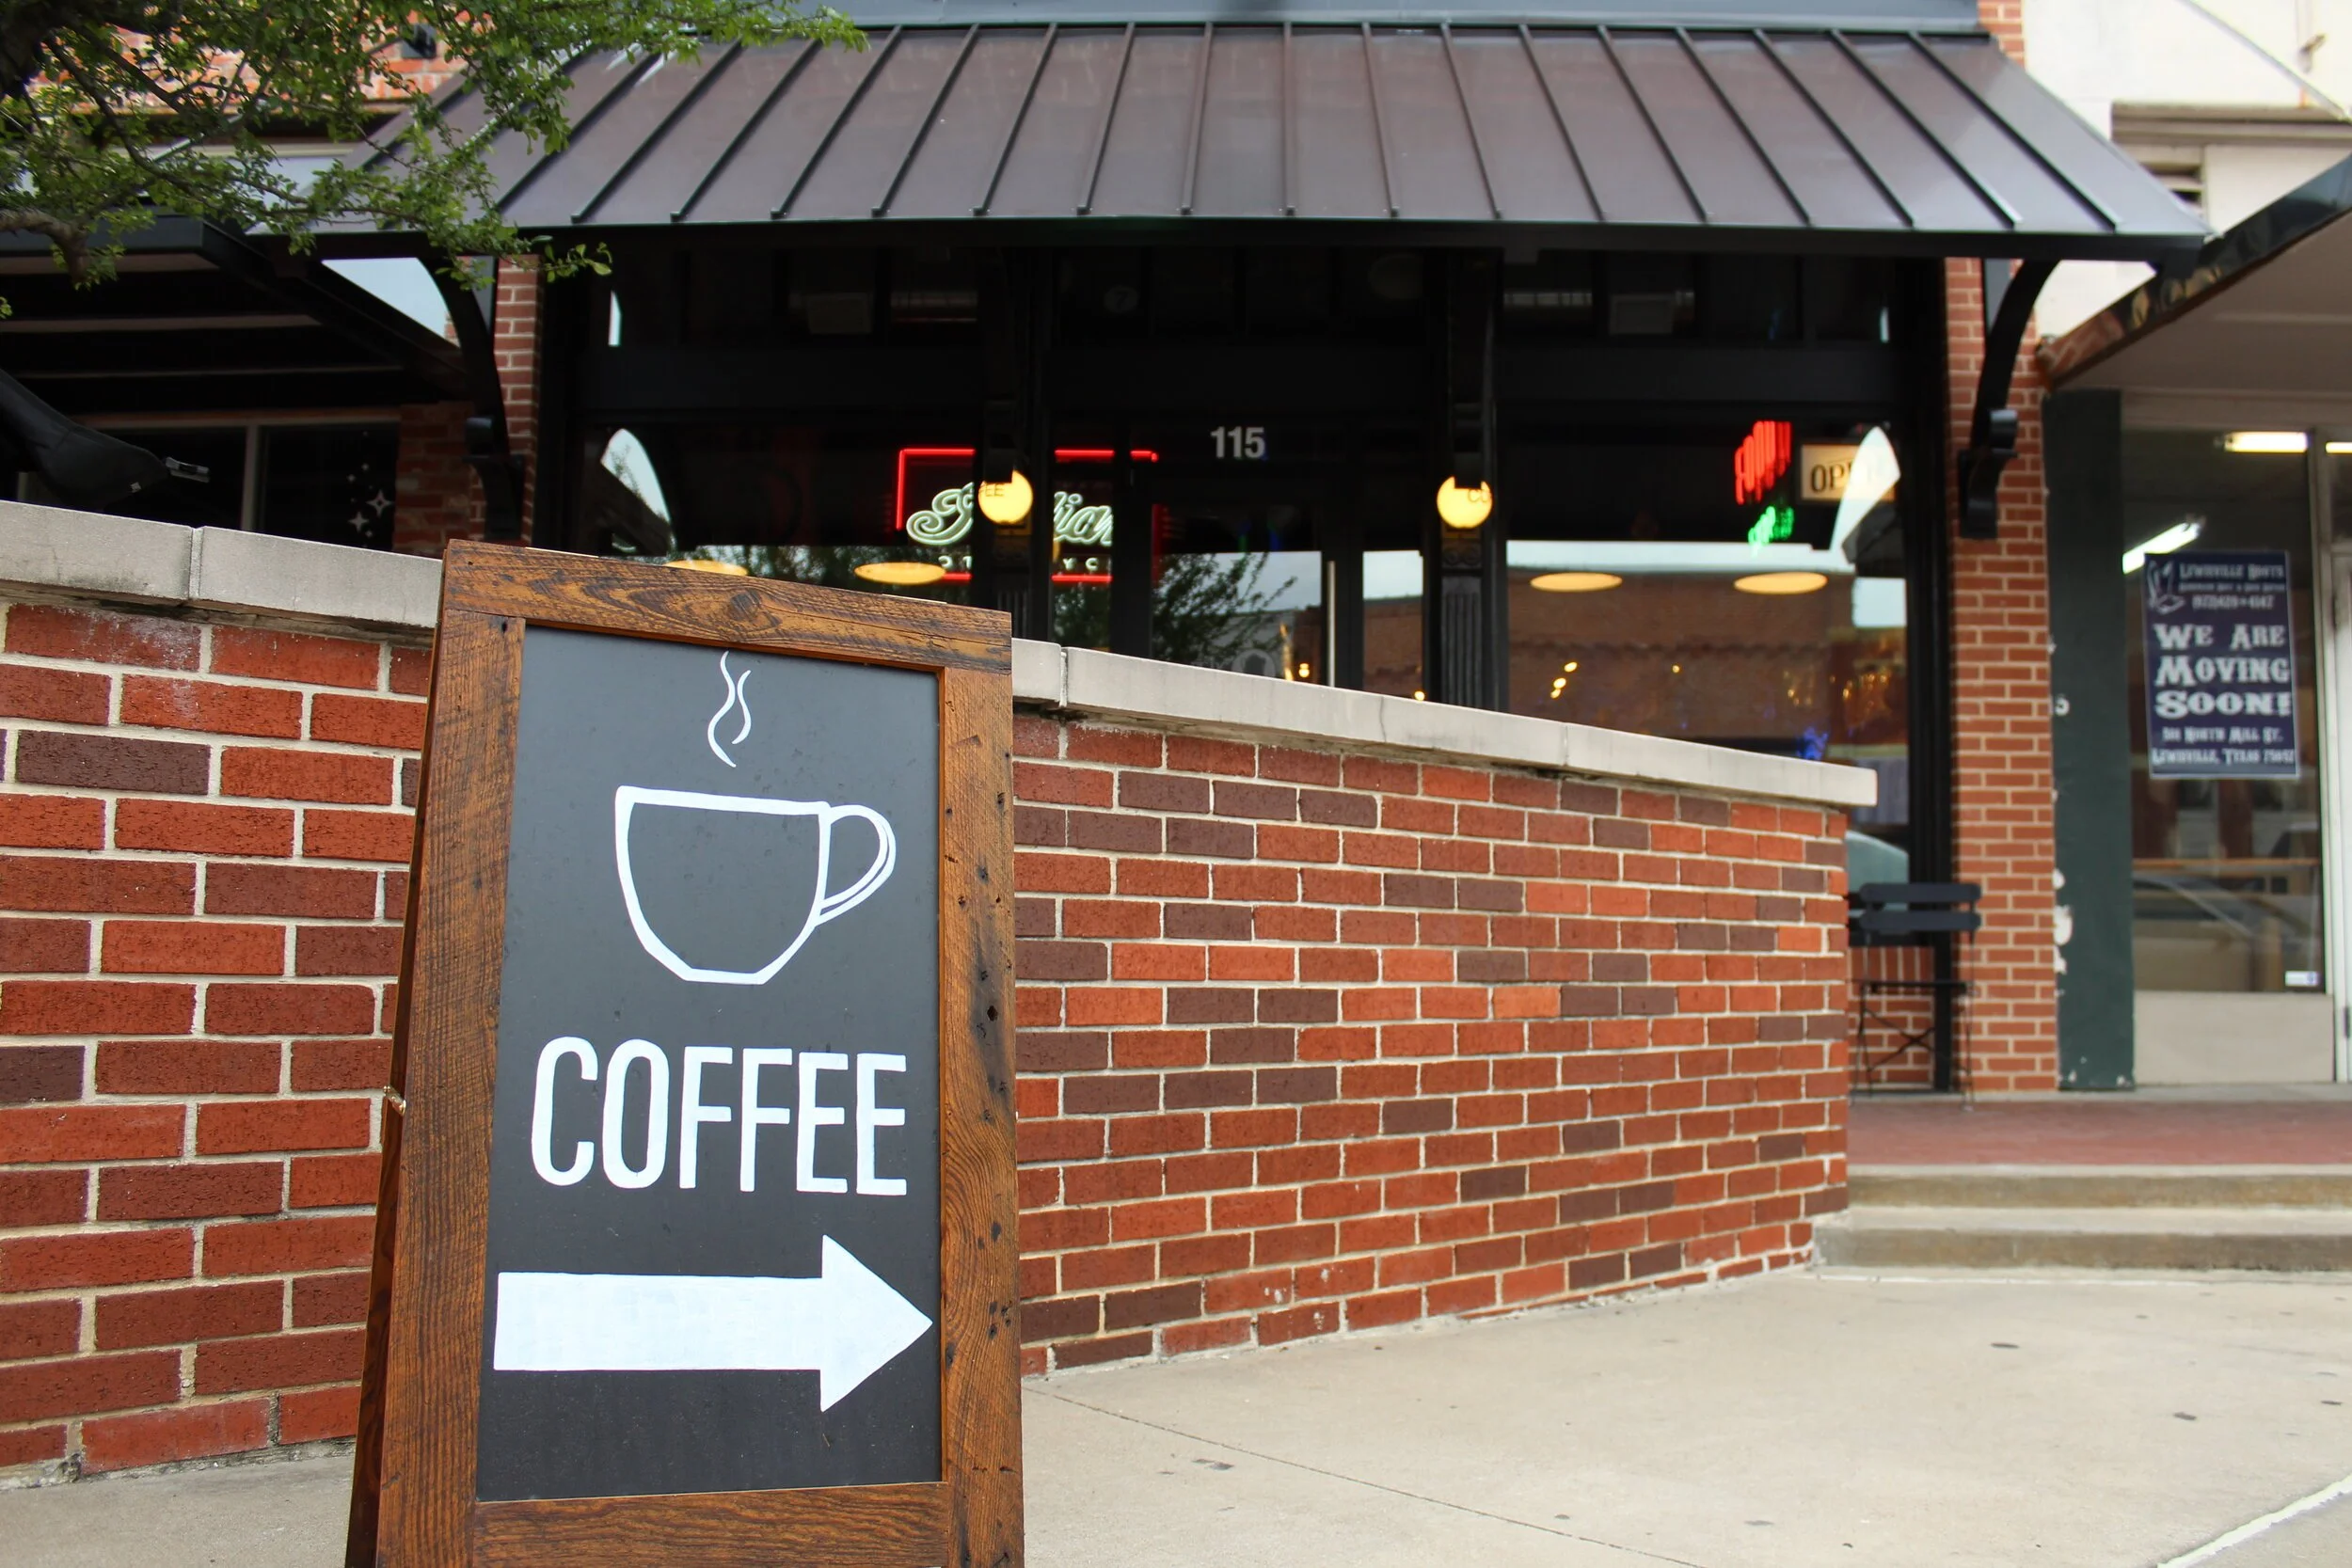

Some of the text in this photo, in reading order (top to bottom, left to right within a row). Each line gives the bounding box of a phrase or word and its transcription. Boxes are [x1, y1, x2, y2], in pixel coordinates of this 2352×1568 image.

[1210, 426, 1265, 458] 115
[2153, 623, 2285, 651] WE ARE
[2154, 655, 2290, 687] MOVING
[2154, 689, 2292, 720] SOON!
[531, 1036, 907, 1196] COFFEE
